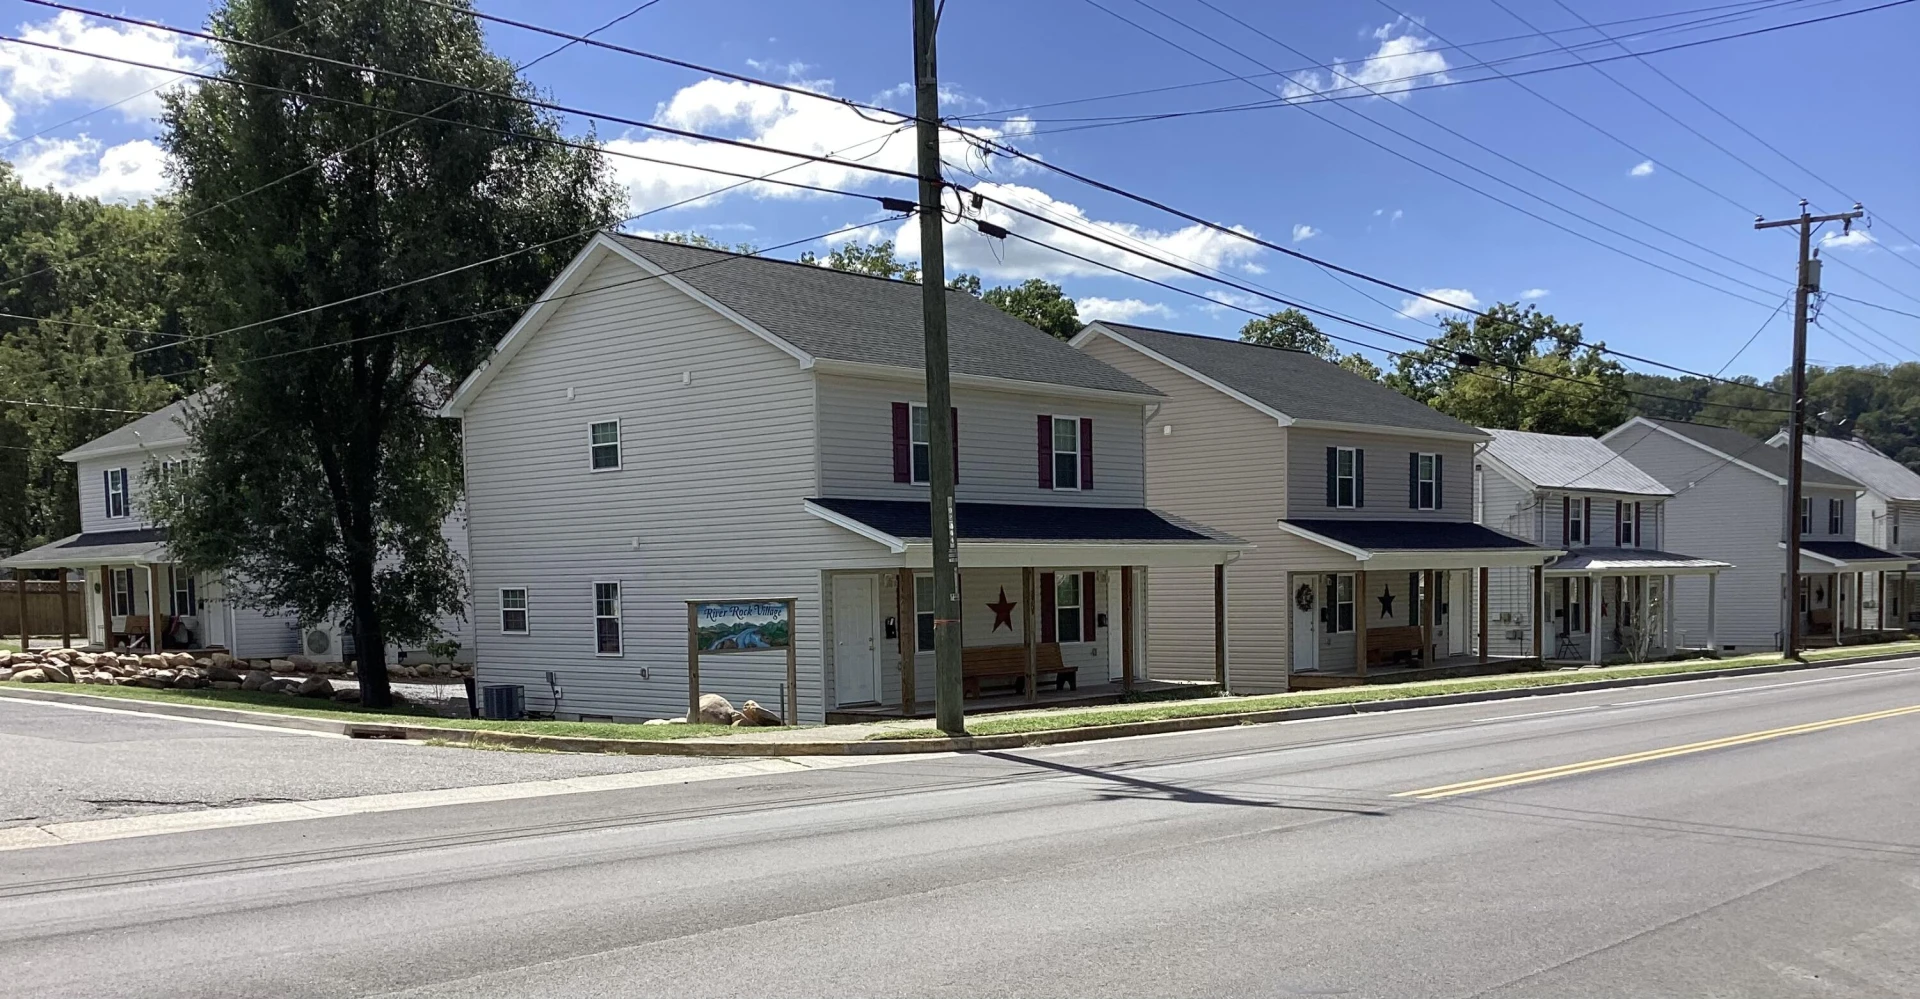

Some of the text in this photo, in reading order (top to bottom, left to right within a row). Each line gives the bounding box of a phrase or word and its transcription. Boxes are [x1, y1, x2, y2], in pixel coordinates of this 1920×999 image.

[703, 604, 782, 622] River Rock Village
